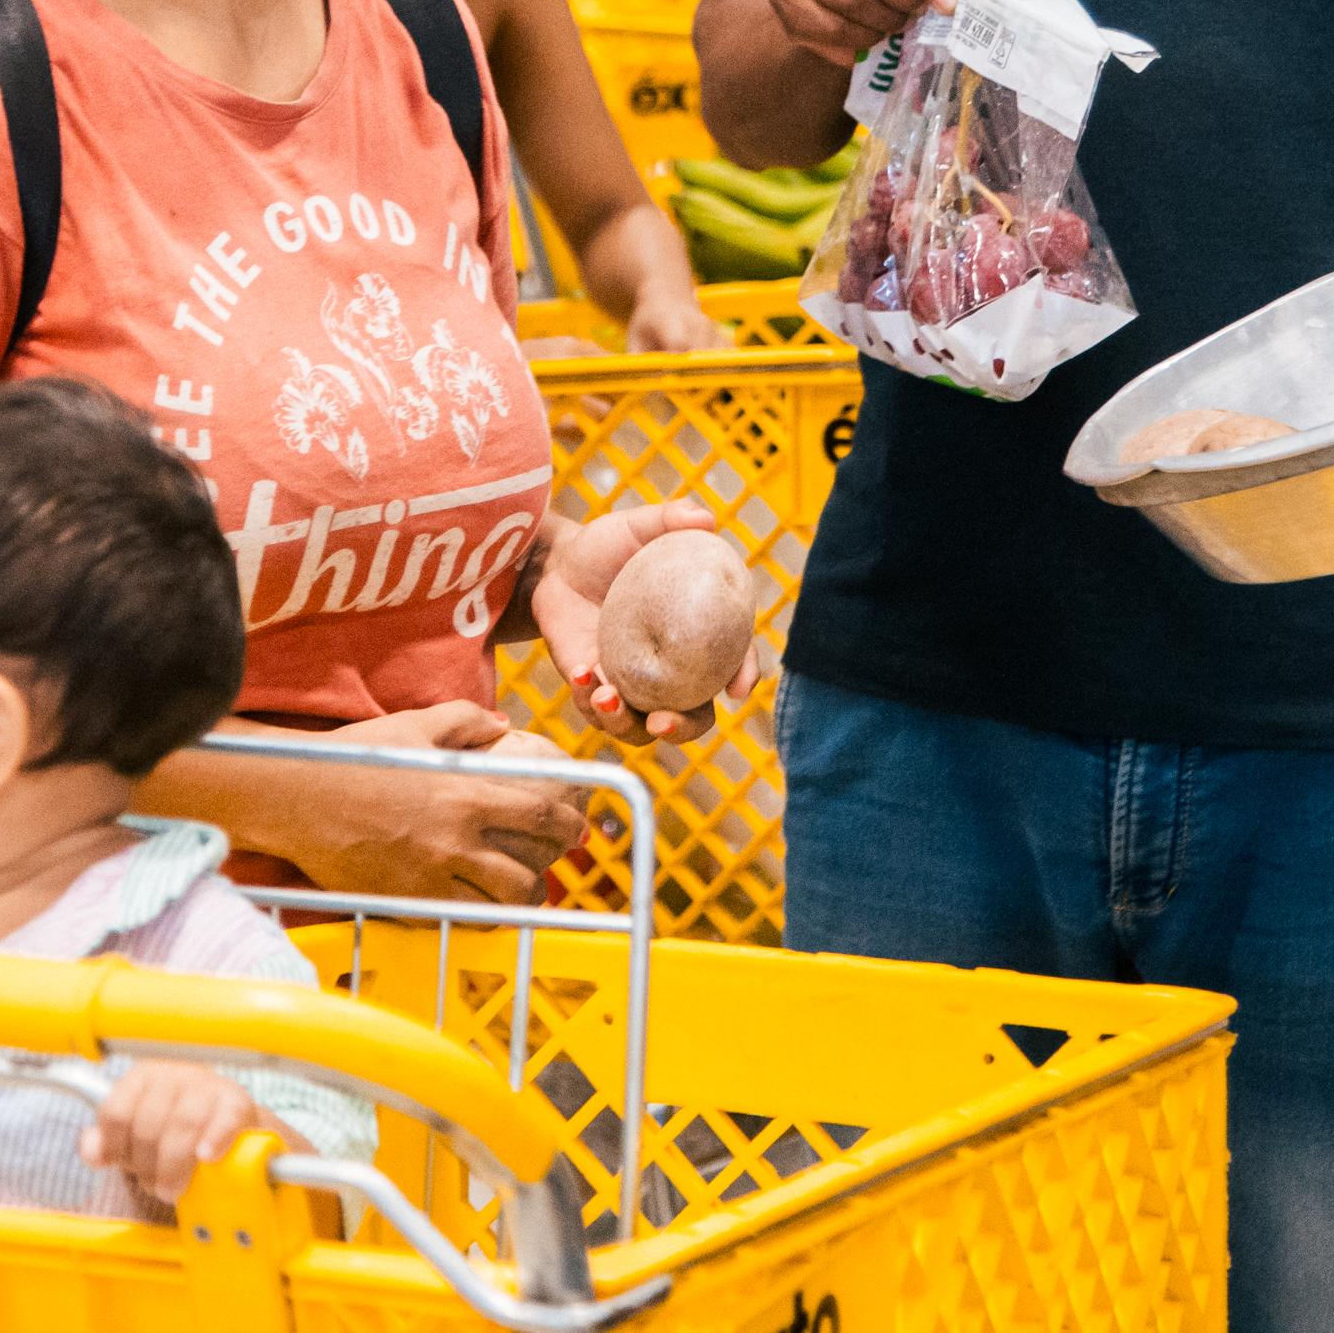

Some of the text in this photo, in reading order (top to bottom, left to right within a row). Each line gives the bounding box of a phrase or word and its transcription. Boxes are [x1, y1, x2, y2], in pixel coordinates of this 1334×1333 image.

[172, 230, 263, 347] THE
[262, 191, 417, 254] GOOD
[442, 221, 488, 305] IN
